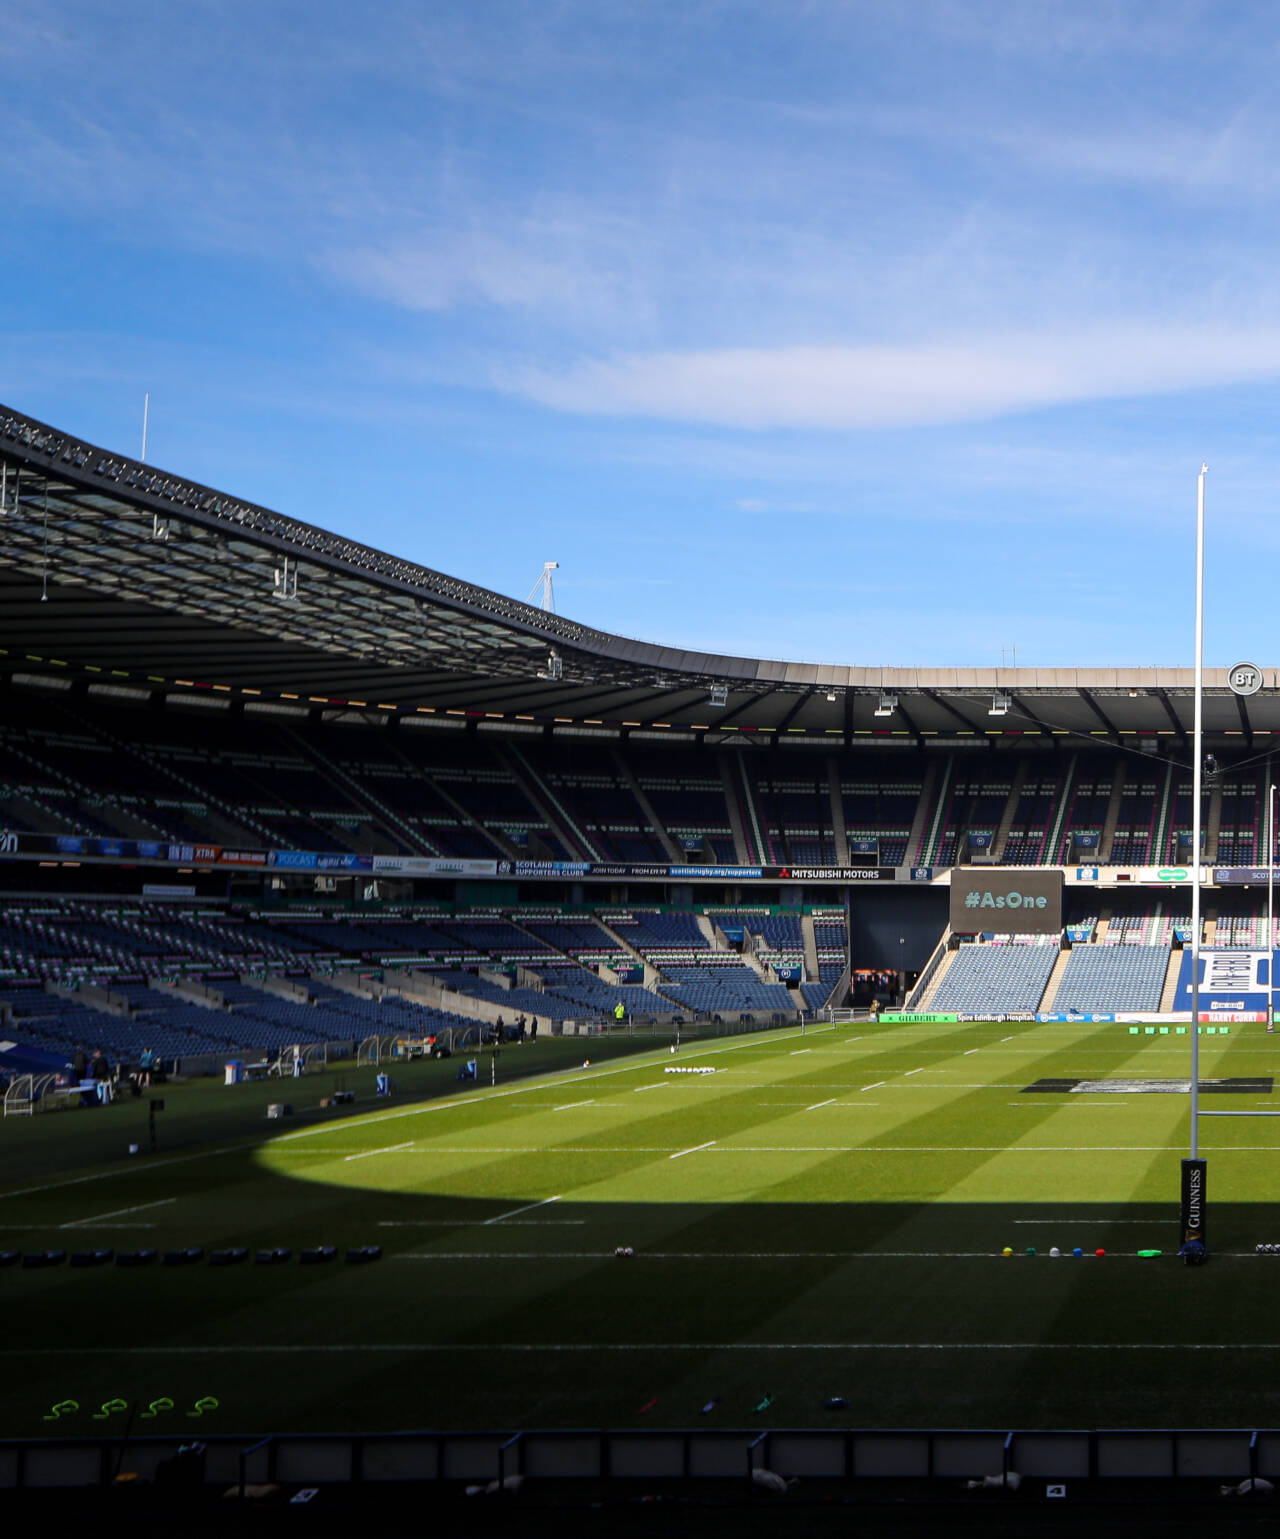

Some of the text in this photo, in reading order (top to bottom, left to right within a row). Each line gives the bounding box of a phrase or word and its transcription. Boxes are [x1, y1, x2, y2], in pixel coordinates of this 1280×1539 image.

[1235, 673, 1255, 685] BT
[516, 861, 553, 869] SCOTLAND
[562, 862, 588, 870] JUNIOR
[516, 868, 584, 877] SUPPORTERS CLUBS
[671, 867, 761, 877] scottishrugby.org/supporters
[791, 870, 880, 879] MITSUBISHI MOTORS
[964, 891, 1048, 909] #AsOne
[898, 1014, 938, 1022] GILBERT
[957, 1014, 973, 1022] Spire
[974, 1014, 1005, 1022] Edinburgh
[1006, 1014, 1036, 1022] Hospitals
[1188, 1169, 1201, 1228] GUINNESS
